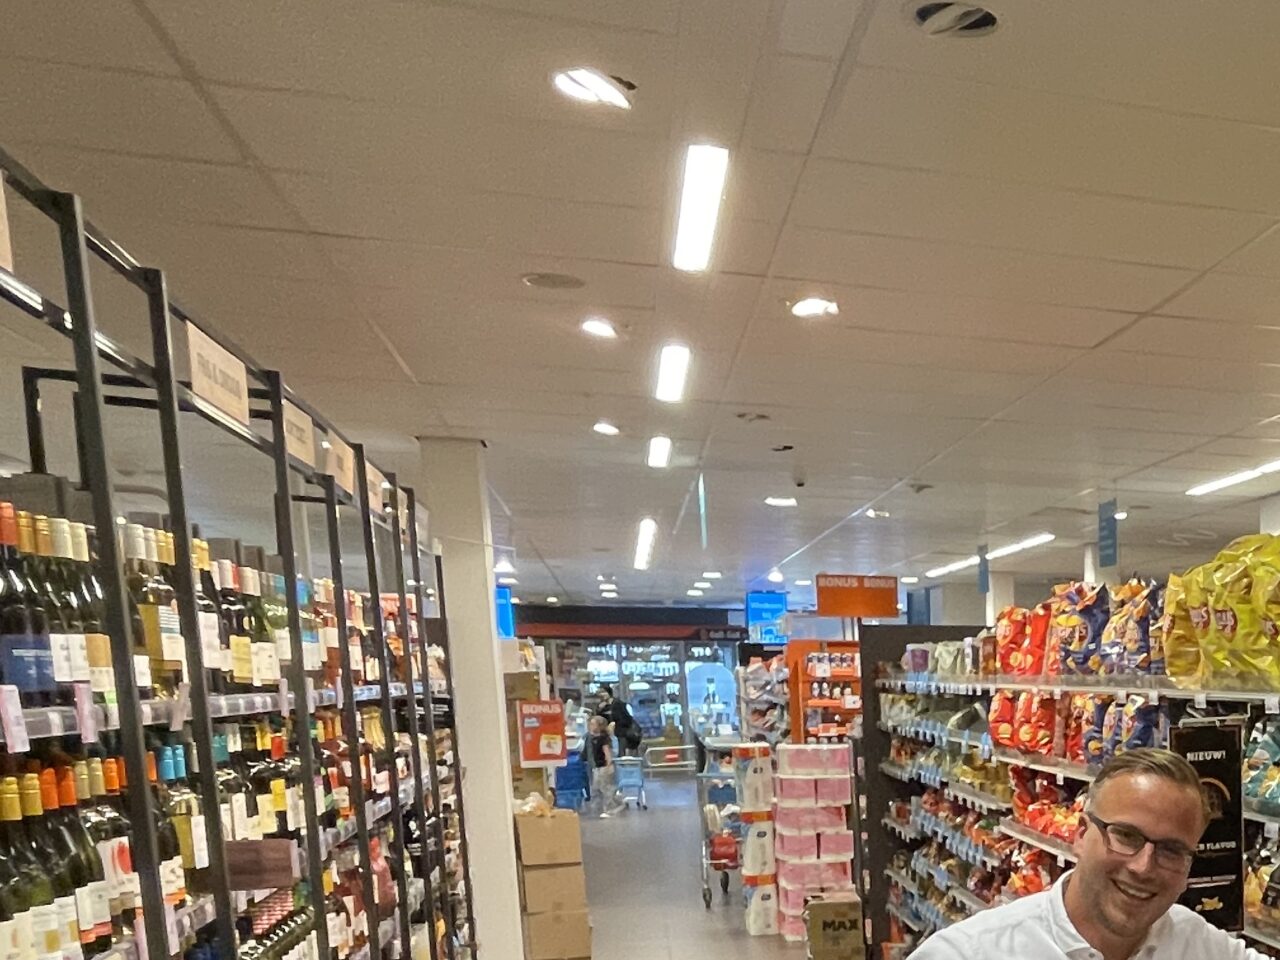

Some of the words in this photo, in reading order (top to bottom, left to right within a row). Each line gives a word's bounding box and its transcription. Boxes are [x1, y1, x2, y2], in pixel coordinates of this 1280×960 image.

[521, 703, 562, 714] BONUS
[1186, 751, 1226, 762] NIEUW!
[822, 918, 859, 932] MAX
